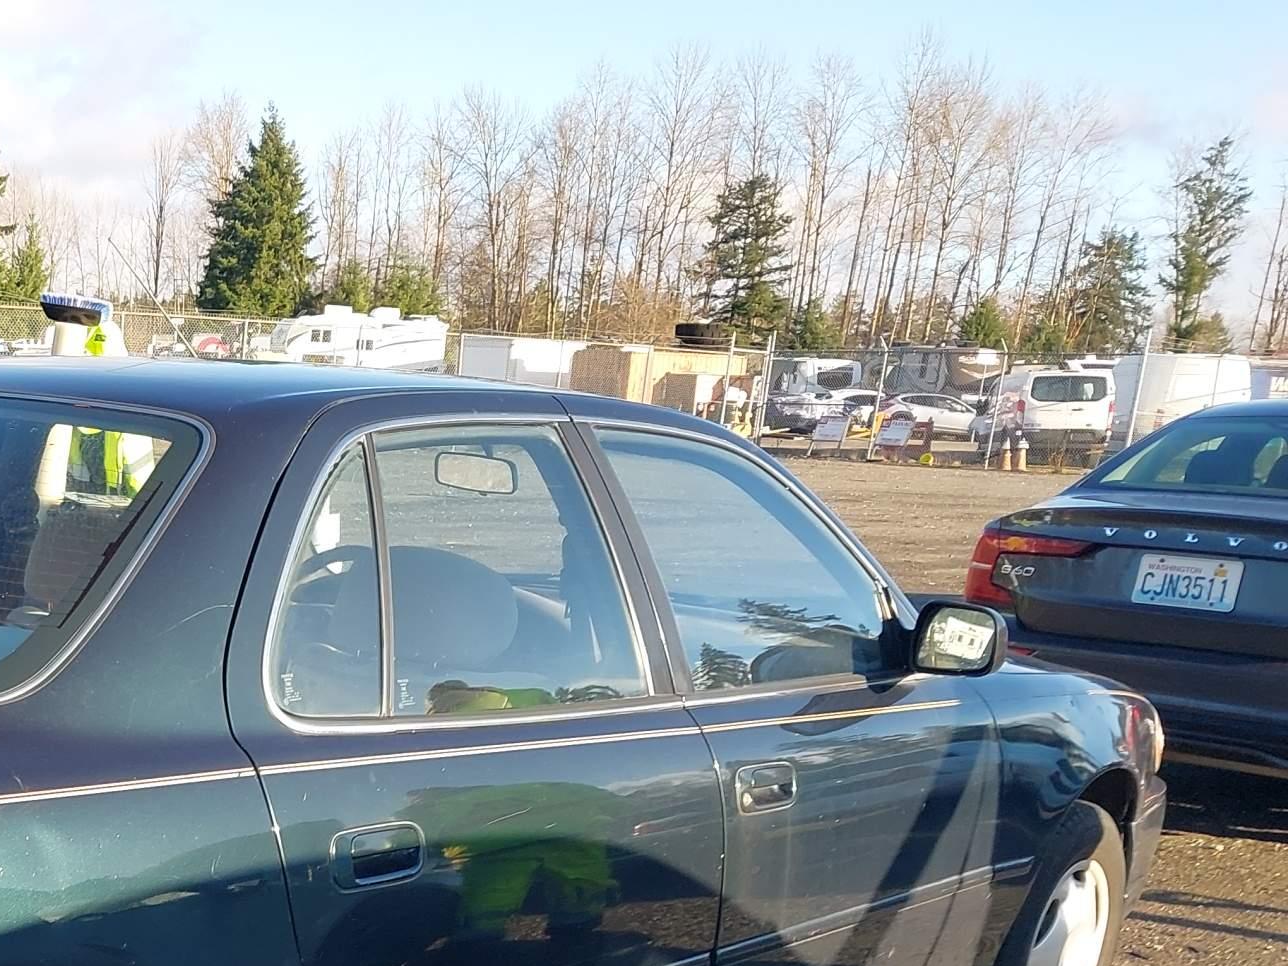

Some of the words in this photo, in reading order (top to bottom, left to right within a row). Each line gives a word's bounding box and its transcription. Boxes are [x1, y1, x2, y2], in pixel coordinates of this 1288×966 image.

[1103, 527, 1288, 551] VOLVO
[1000, 564, 1036, 577] S60
[1147, 563, 1203, 574] WASHINGTON
[1140, 572, 1229, 604] CJN3511
